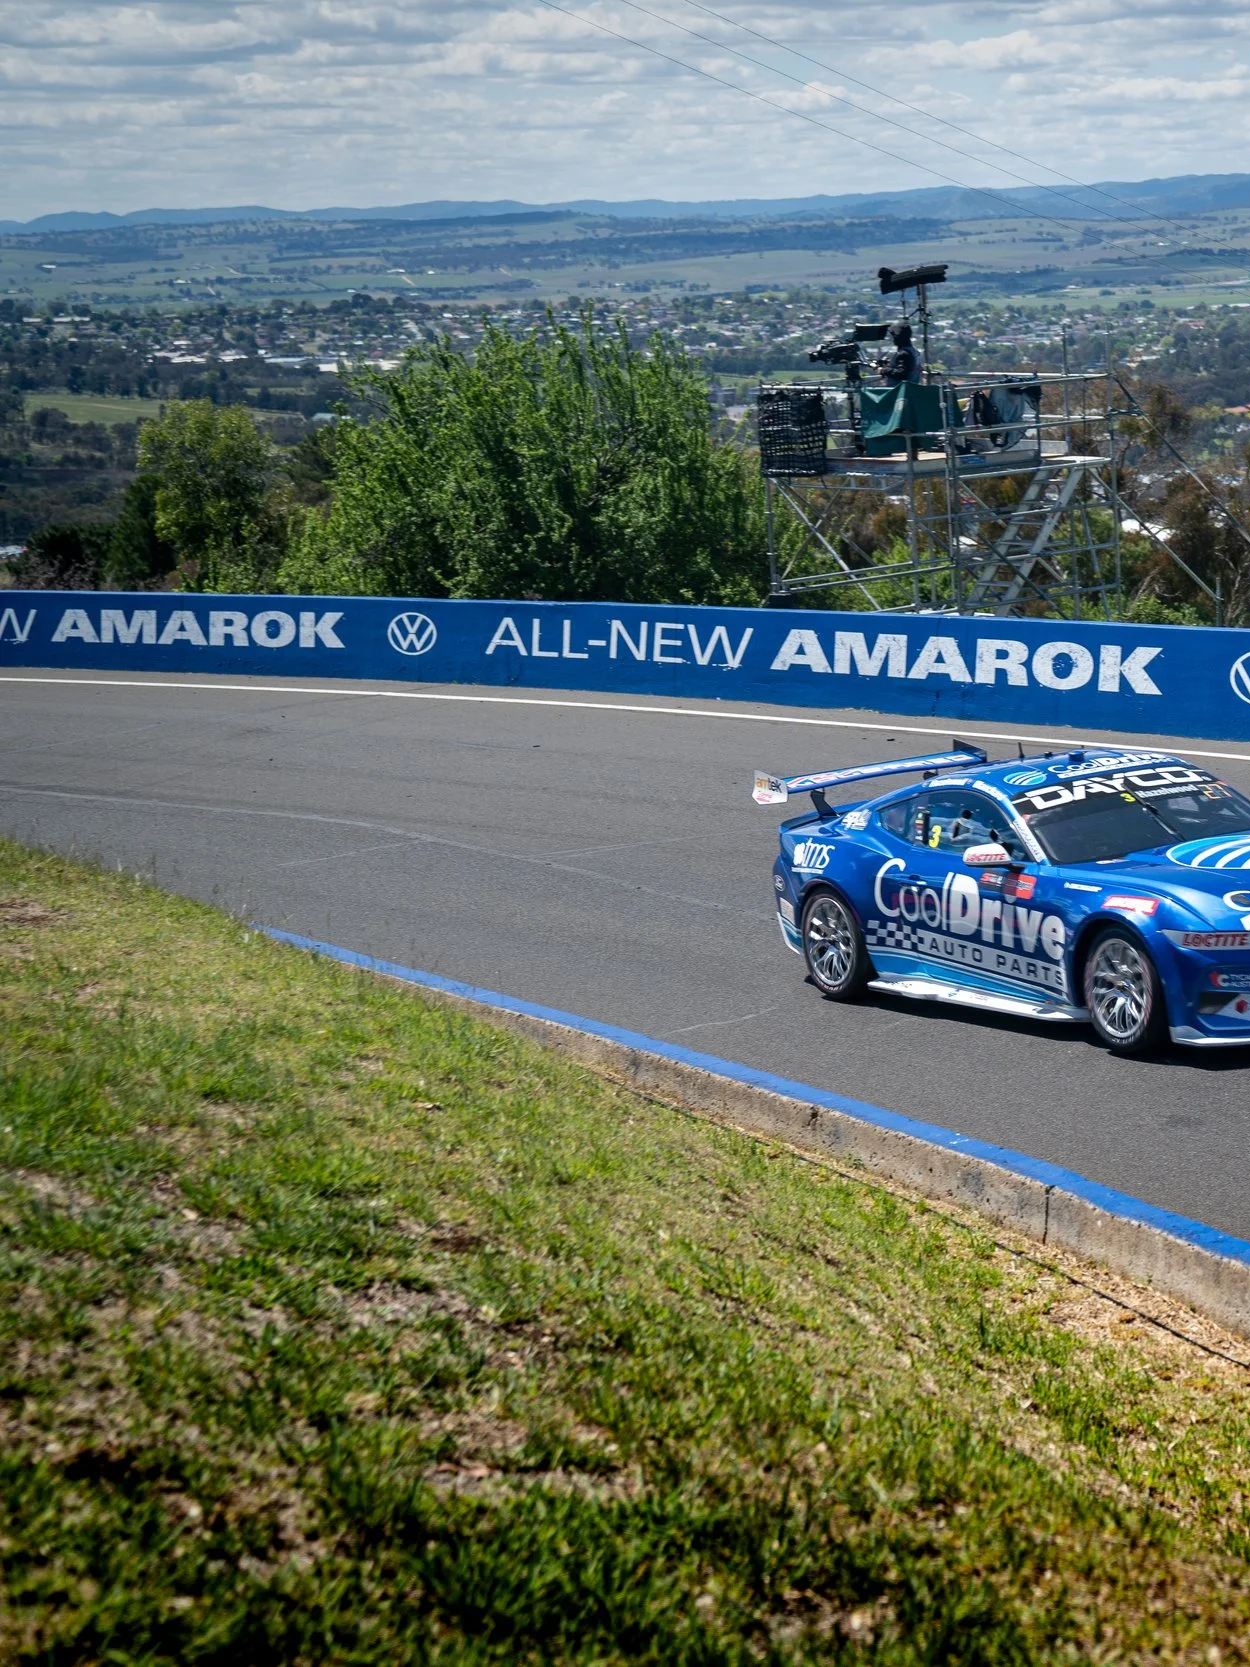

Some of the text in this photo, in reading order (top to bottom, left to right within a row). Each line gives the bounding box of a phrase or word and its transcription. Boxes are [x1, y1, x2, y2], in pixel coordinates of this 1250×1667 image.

[51, 609, 345, 648] AMAROK
[485, 617, 1163, 696] ALL-NEW AMAROK
[1120, 792, 1136, 803] 3
[928, 825, 942, 848] 3
[873, 857, 1066, 961] CoolDrive
[1181, 932, 1249, 947] LOCTITE
[929, 937, 1065, 987] AUTO PARTS
